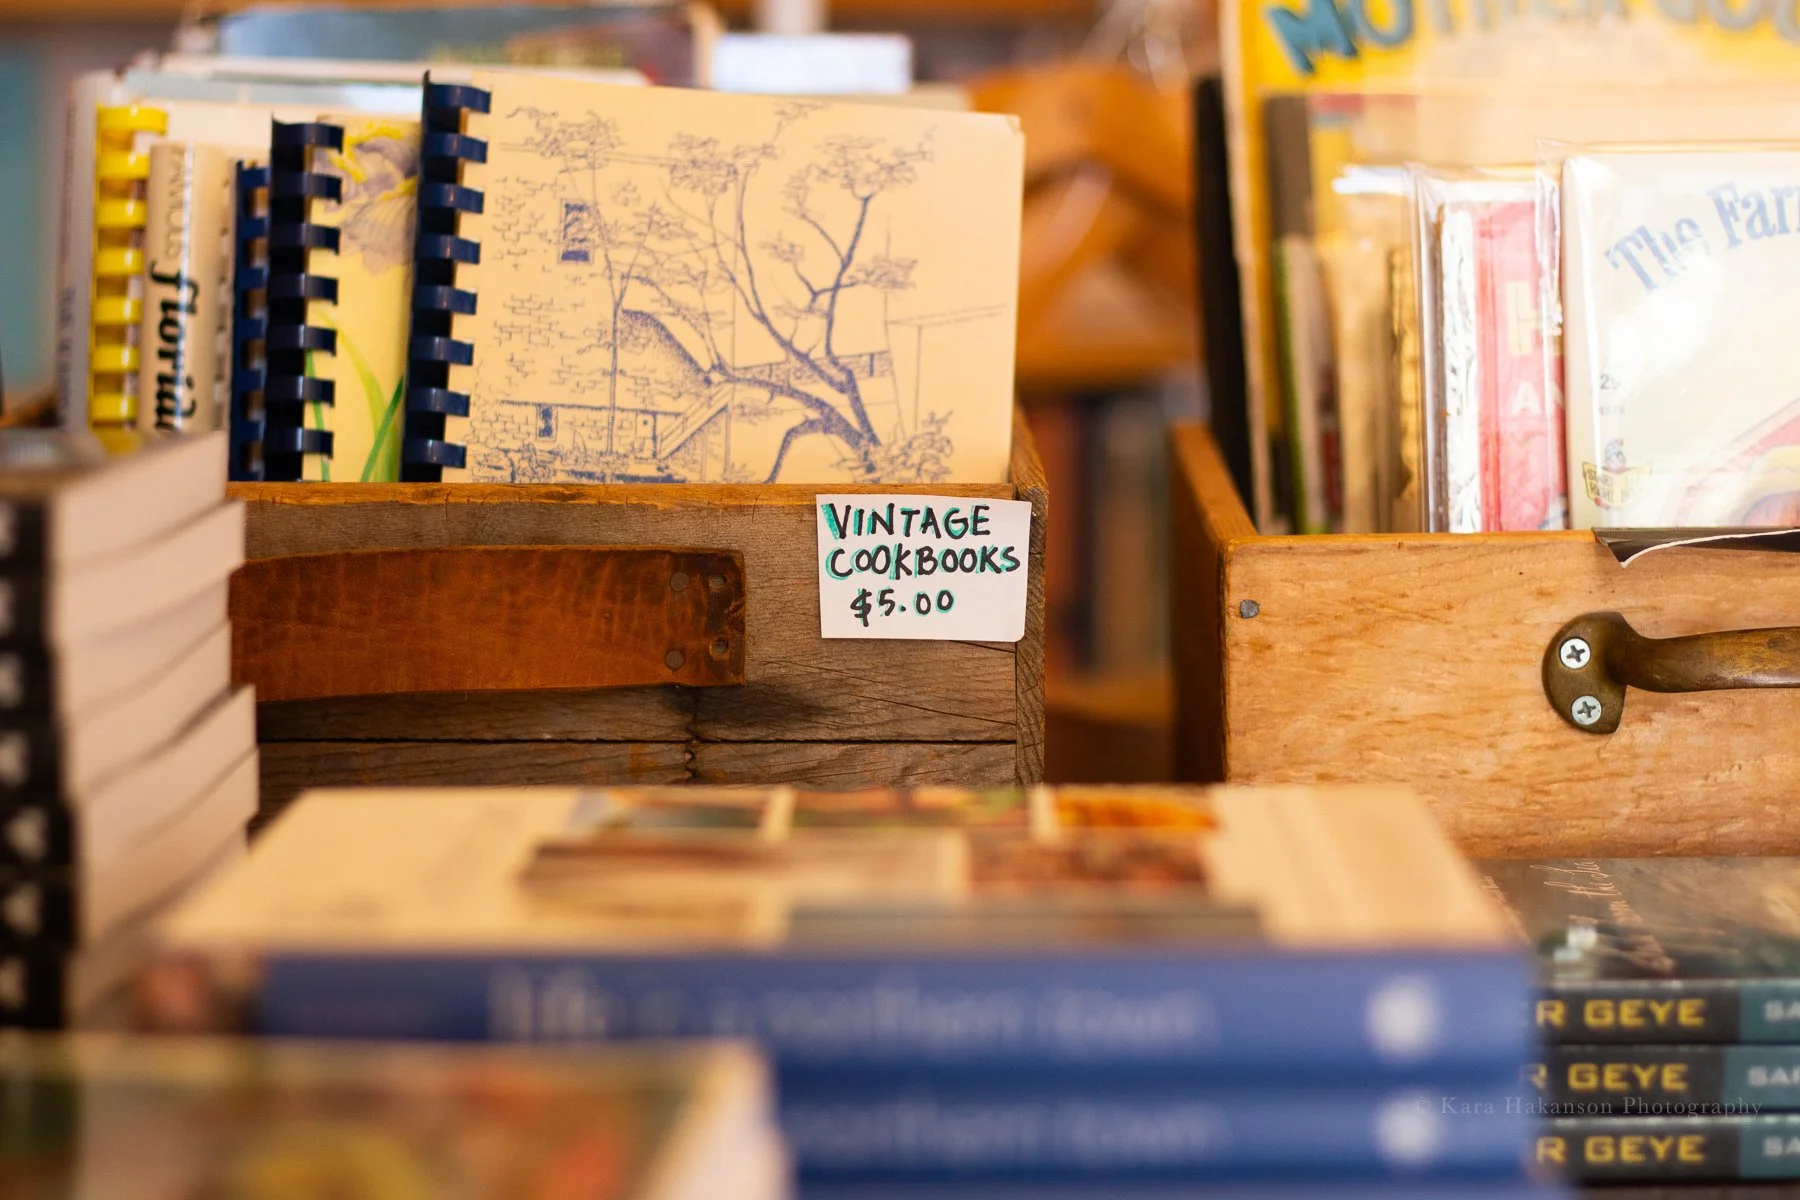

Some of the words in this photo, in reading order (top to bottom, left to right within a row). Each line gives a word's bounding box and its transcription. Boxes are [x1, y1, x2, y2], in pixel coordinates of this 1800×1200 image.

[1706, 181, 1800, 249] Far
[821, 502, 991, 539] VINTAGE
[825, 543, 1021, 580] COOKBOOKS
[850, 586, 955, 628] $5.00
[1583, 998, 1706, 1028] GEYE
[1567, 1062, 1689, 1091] GEYE
[1583, 1135, 1707, 1164] GEYE
